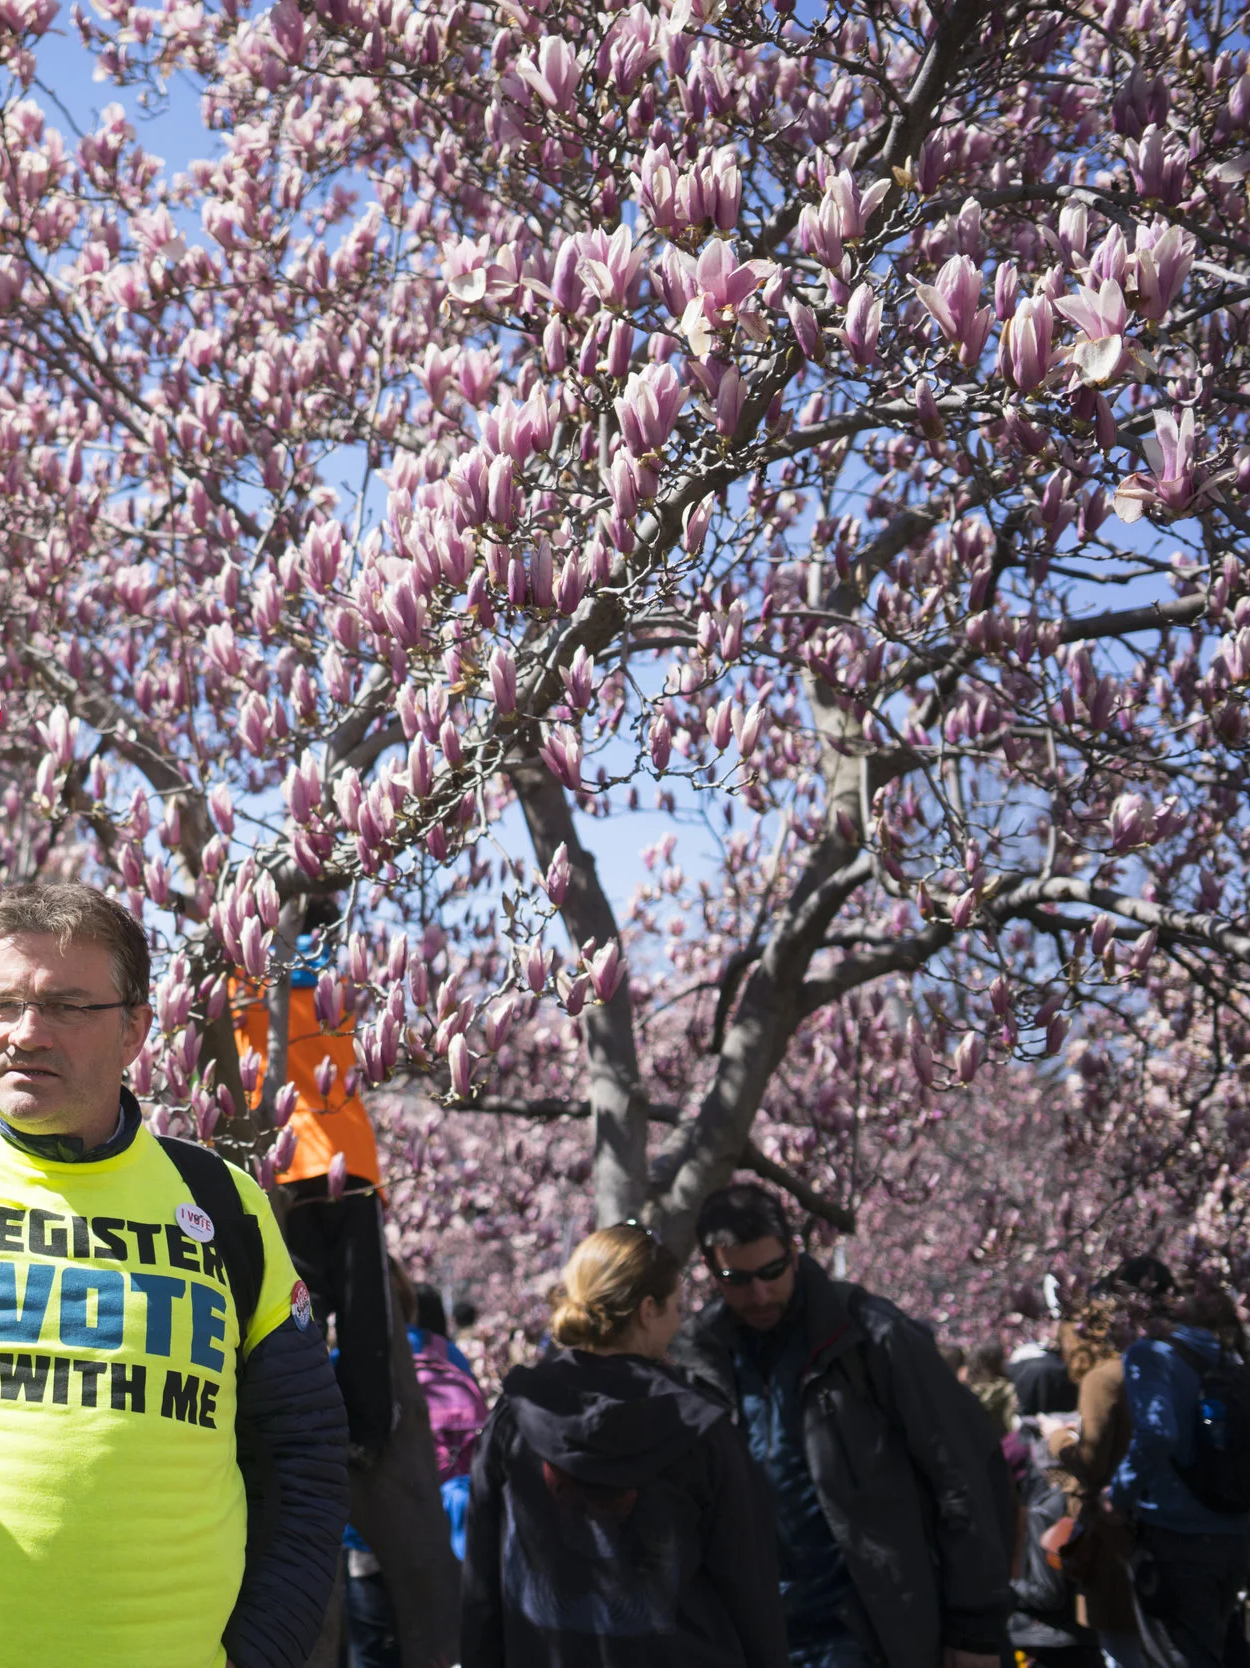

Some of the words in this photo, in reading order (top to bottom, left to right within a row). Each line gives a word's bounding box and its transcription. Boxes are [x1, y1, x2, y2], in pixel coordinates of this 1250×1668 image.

[181, 1208, 185, 1219] I
[187, 1210, 212, 1232] VOTE
[0, 1352, 147, 1414] WITH
[160, 1370, 220, 1430] ME
